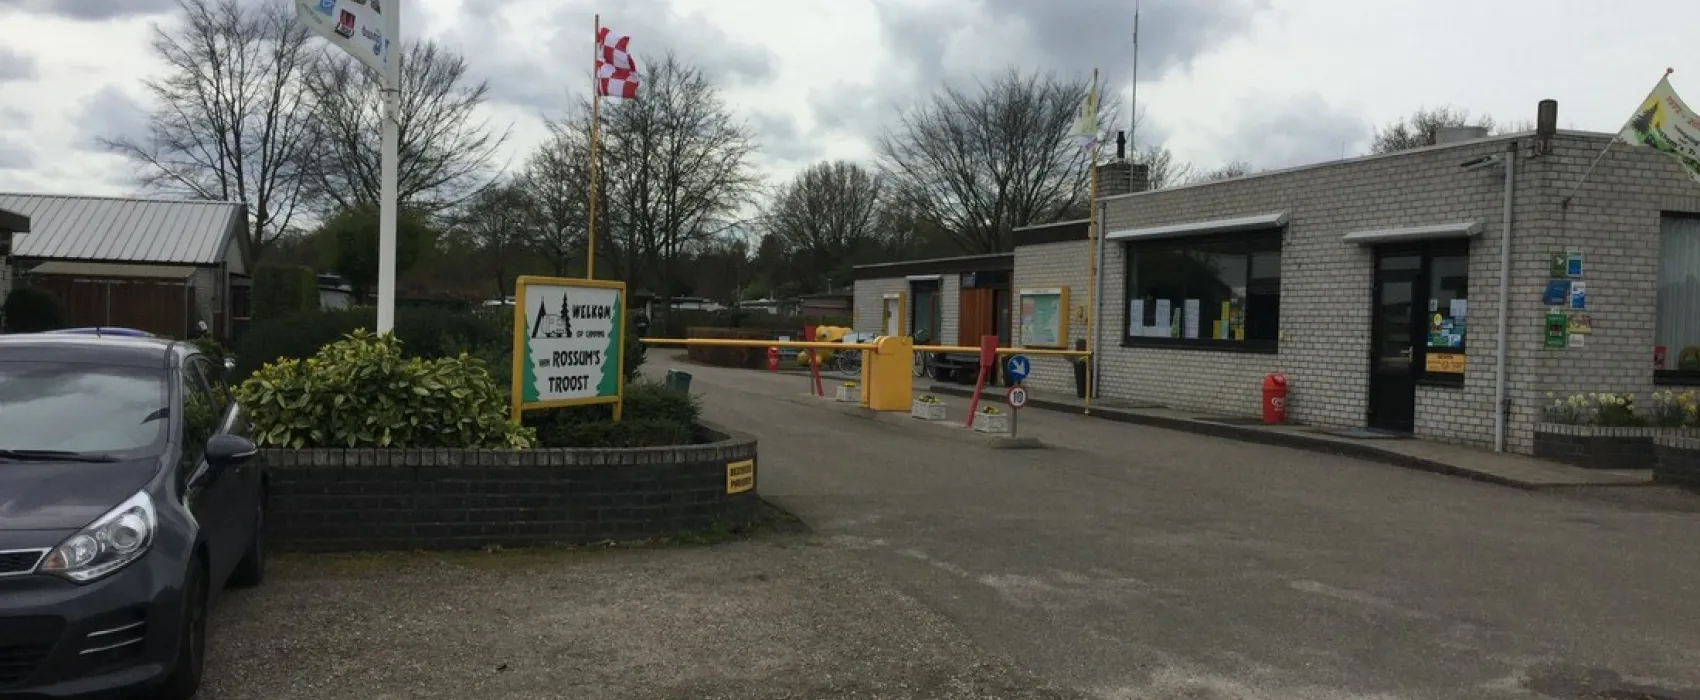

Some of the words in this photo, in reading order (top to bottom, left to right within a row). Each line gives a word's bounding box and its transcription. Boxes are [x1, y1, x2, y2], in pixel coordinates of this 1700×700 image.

[572, 305, 611, 318] WELKOM
[553, 350, 600, 367] ROSSUM'S
[548, 375, 589, 393] TROOST
[1013, 391, 1023, 403] 10
